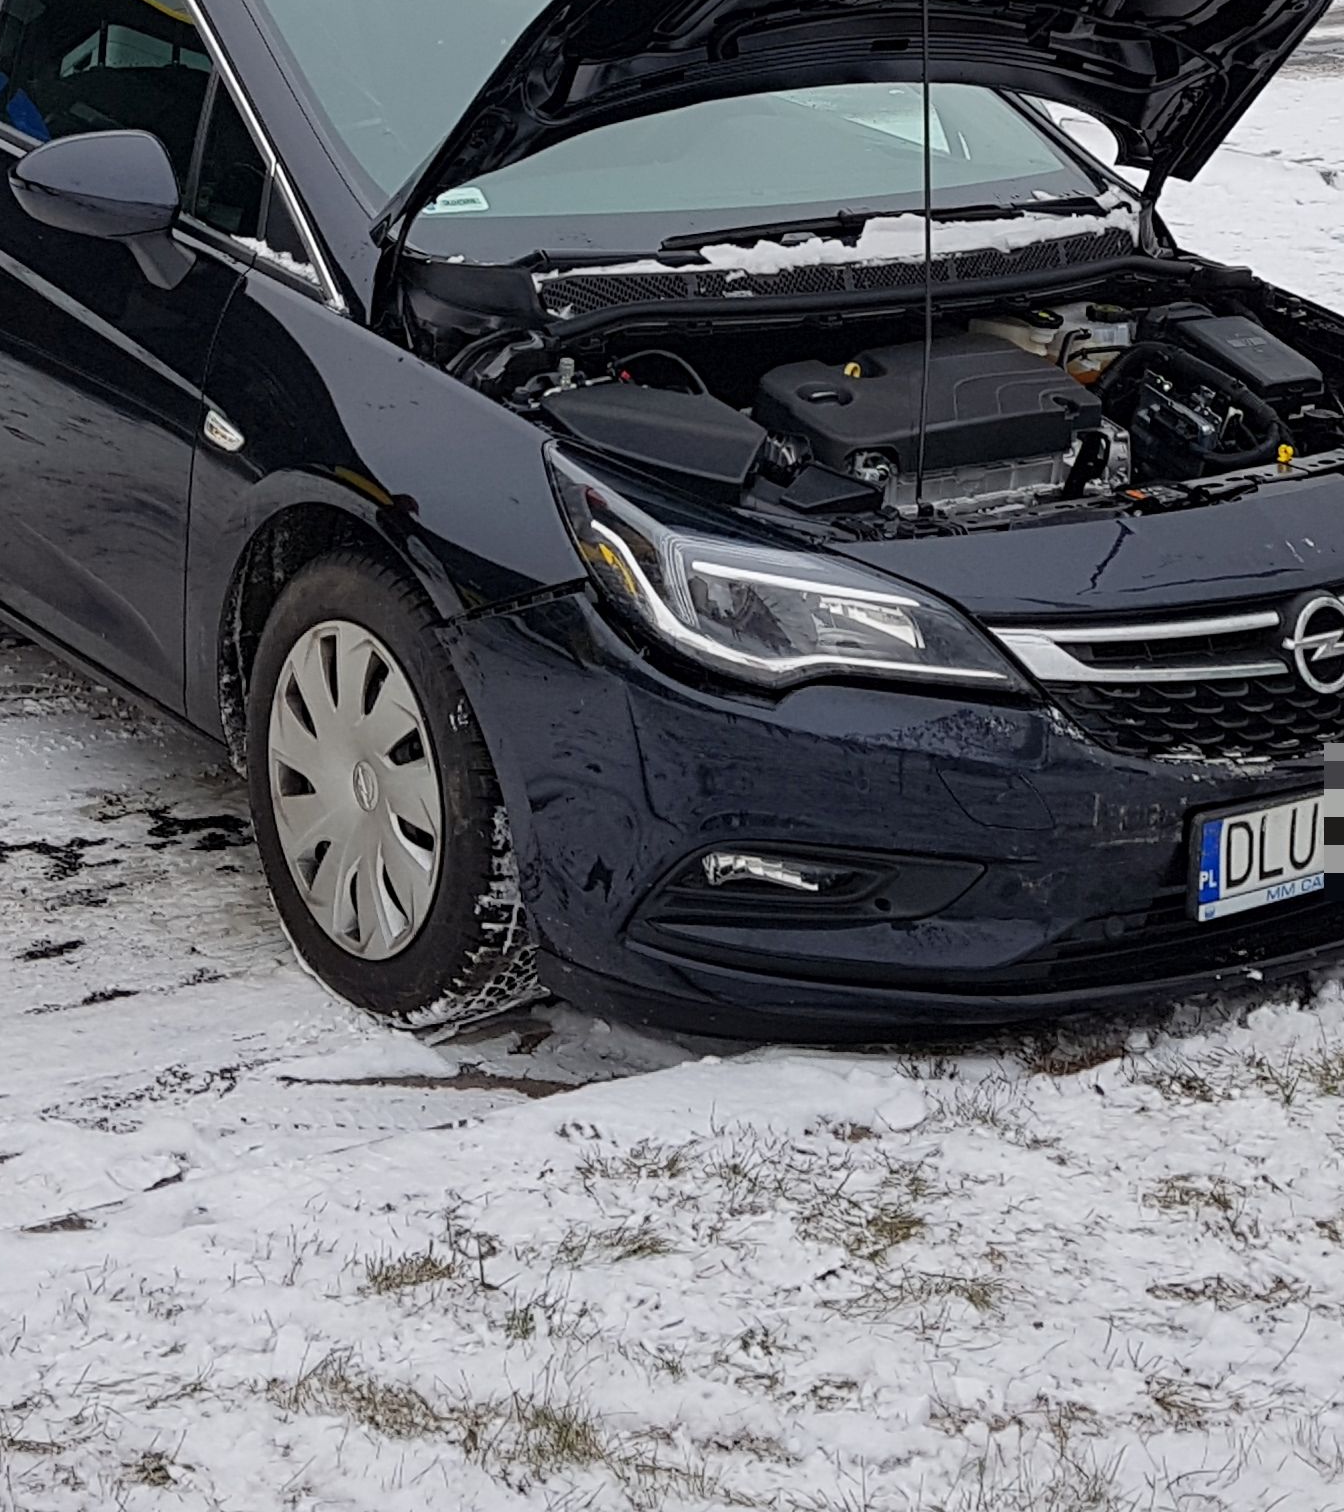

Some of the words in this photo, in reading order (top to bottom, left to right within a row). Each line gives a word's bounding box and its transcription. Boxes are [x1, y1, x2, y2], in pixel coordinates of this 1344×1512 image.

[1199, 869, 1218, 891] PL
[1226, 802, 1319, 890] DLU
[1266, 882, 1296, 902] MM
